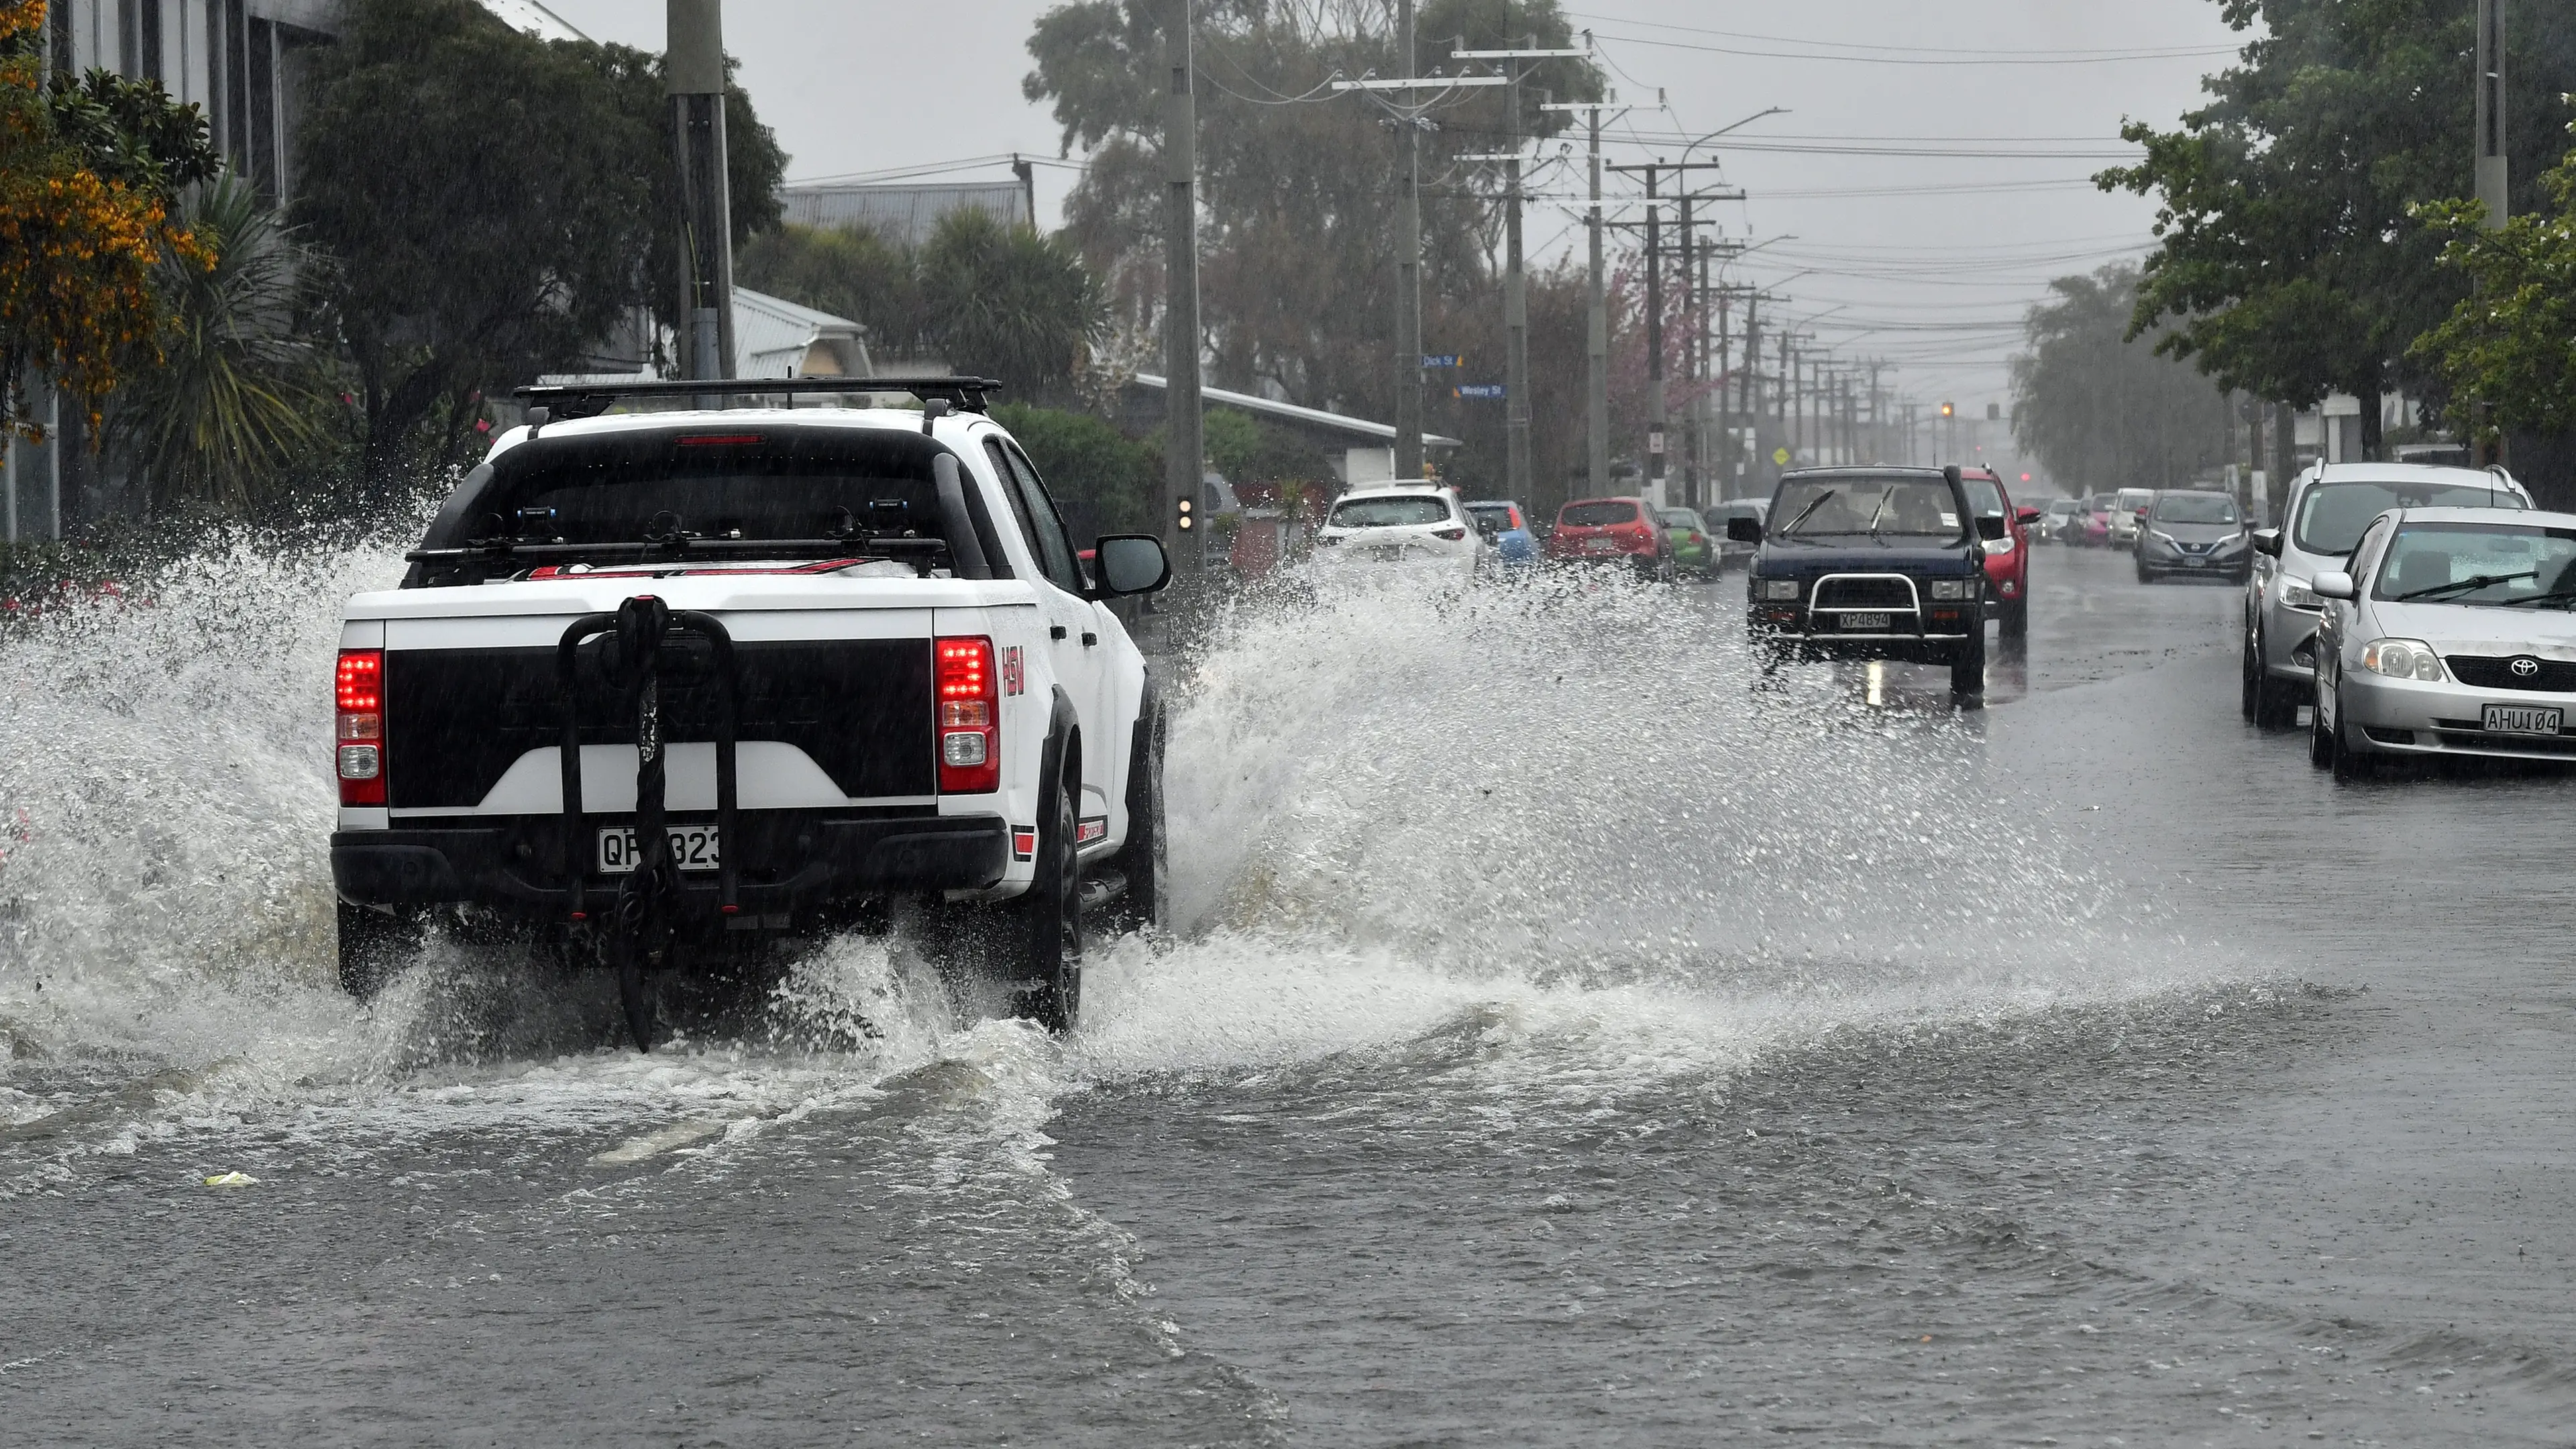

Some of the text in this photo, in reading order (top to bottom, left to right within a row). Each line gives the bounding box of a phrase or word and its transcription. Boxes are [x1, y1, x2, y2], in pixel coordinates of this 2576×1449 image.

[1444, 356, 1452, 365] St
[1492, 385, 1501, 394] St
[1841, 613, 1888, 627] XP4894
[1002, 645, 1024, 698] HSV
[2487, 709, 2557, 732] AHU104
